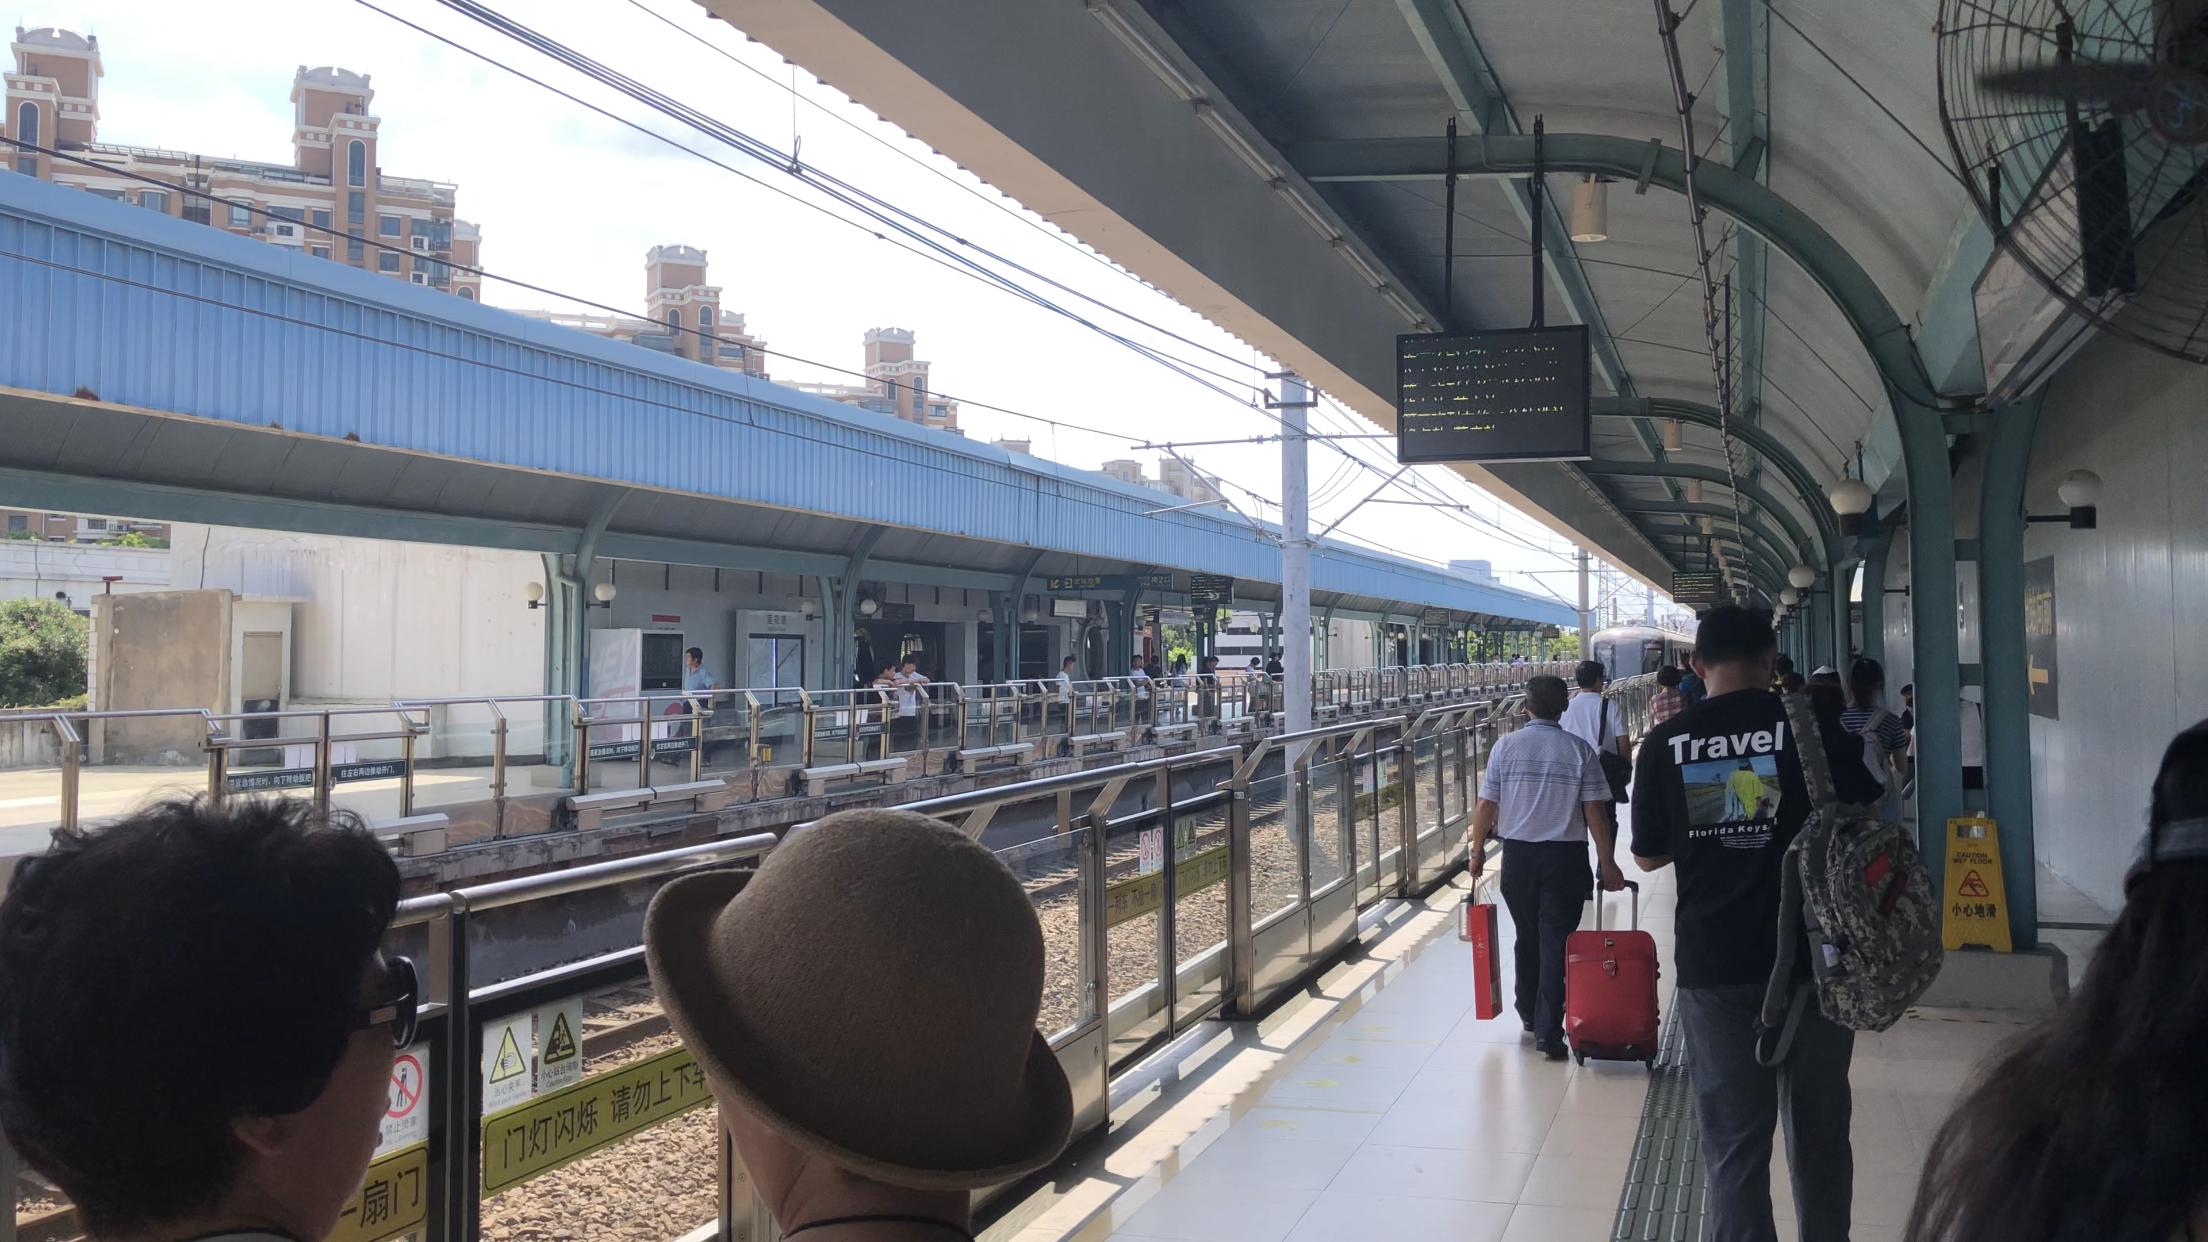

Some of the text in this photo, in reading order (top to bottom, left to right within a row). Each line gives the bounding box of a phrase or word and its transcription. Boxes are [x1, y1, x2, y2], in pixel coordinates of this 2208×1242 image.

[1668, 721, 1785, 765] Travel
[1689, 827, 1734, 839] Florida
[1956, 851, 1988, 859] CAUTION
[1952, 902, 1996, 918] 小心地滑
[504, 1062, 706, 1169] 门灯闪烁 请勿上下车
